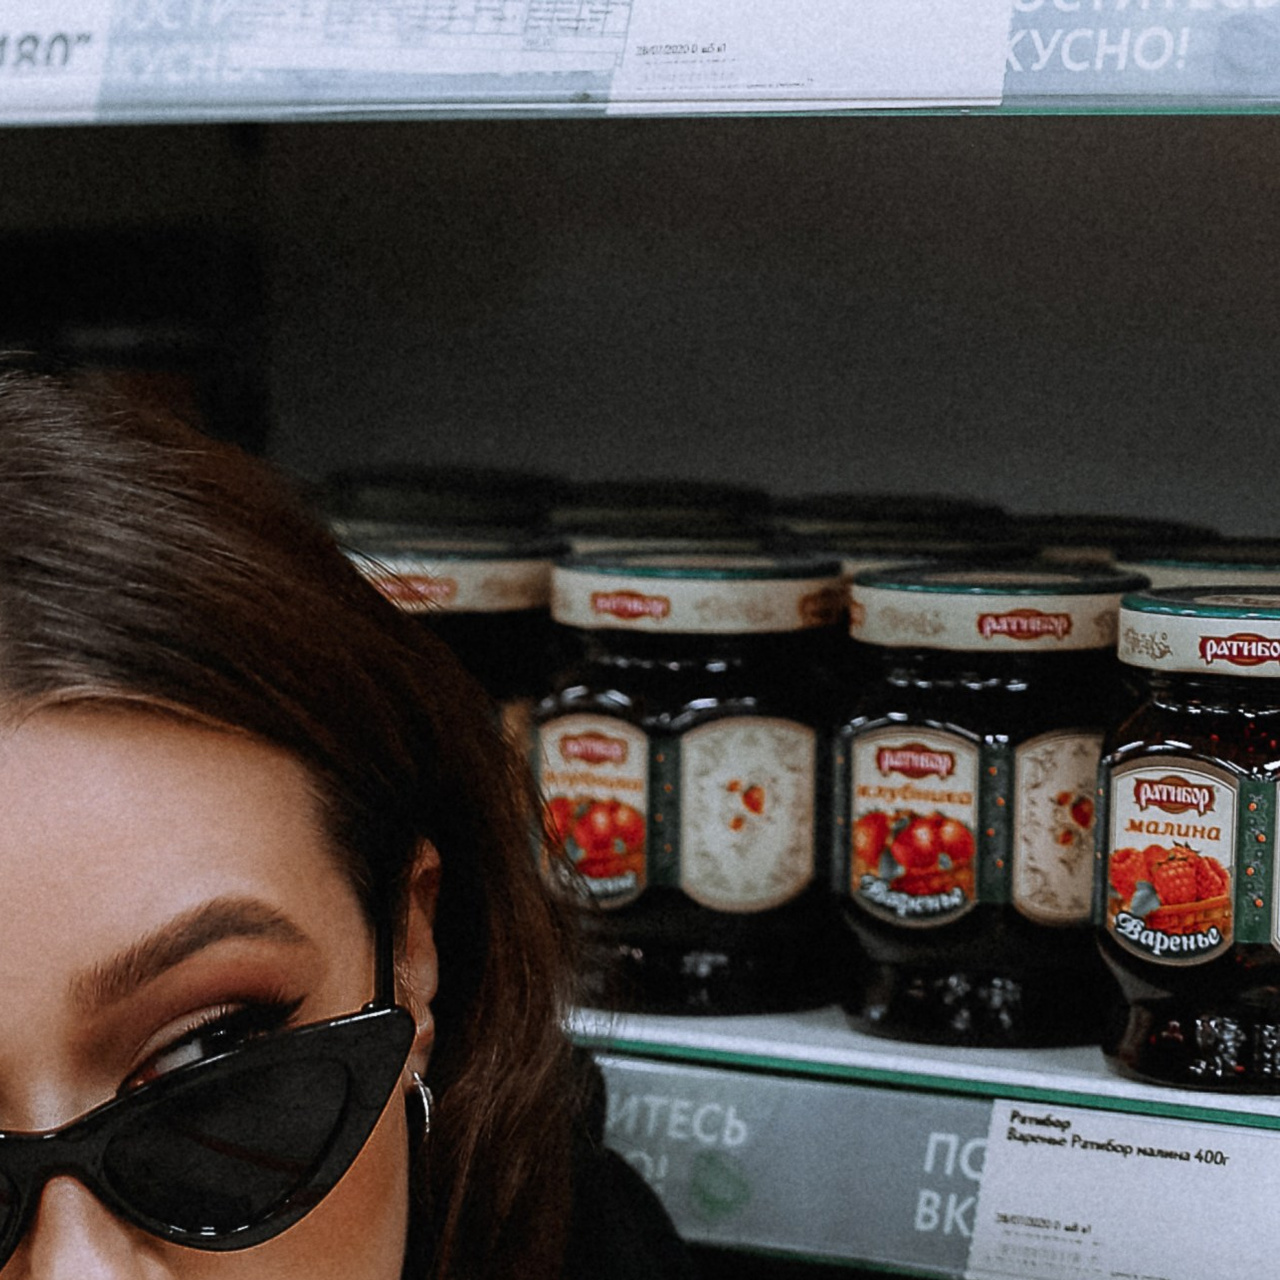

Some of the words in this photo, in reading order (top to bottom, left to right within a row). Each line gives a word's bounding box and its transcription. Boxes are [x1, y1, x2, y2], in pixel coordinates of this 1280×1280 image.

[1141, 783, 1210, 813] РАТИБОР
[1124, 818, 1221, 842] малина
[1116, 912, 1221, 956] Варенье
[1010, 1109, 1071, 1133] Ратибор
[1071, 1134, 1133, 1158] Ратибор
[1136, 1147, 1191, 1162] малина
